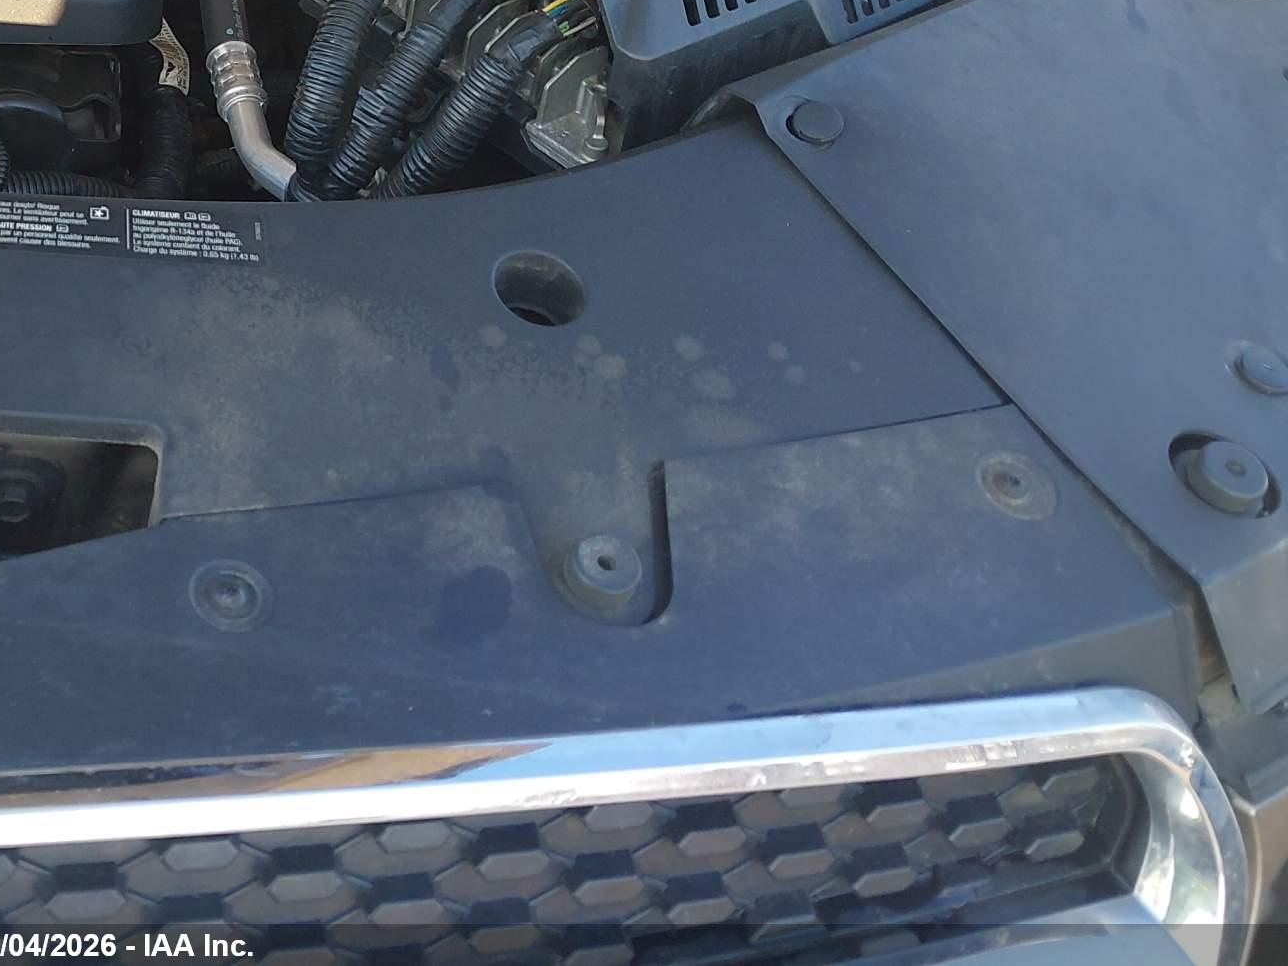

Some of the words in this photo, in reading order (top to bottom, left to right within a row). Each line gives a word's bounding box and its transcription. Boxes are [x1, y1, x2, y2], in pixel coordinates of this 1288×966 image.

[132, 210, 180, 219] CLIMATISEUR
[16, 222, 52, 232] PRESSION
[220, 252, 229, 260] kg
